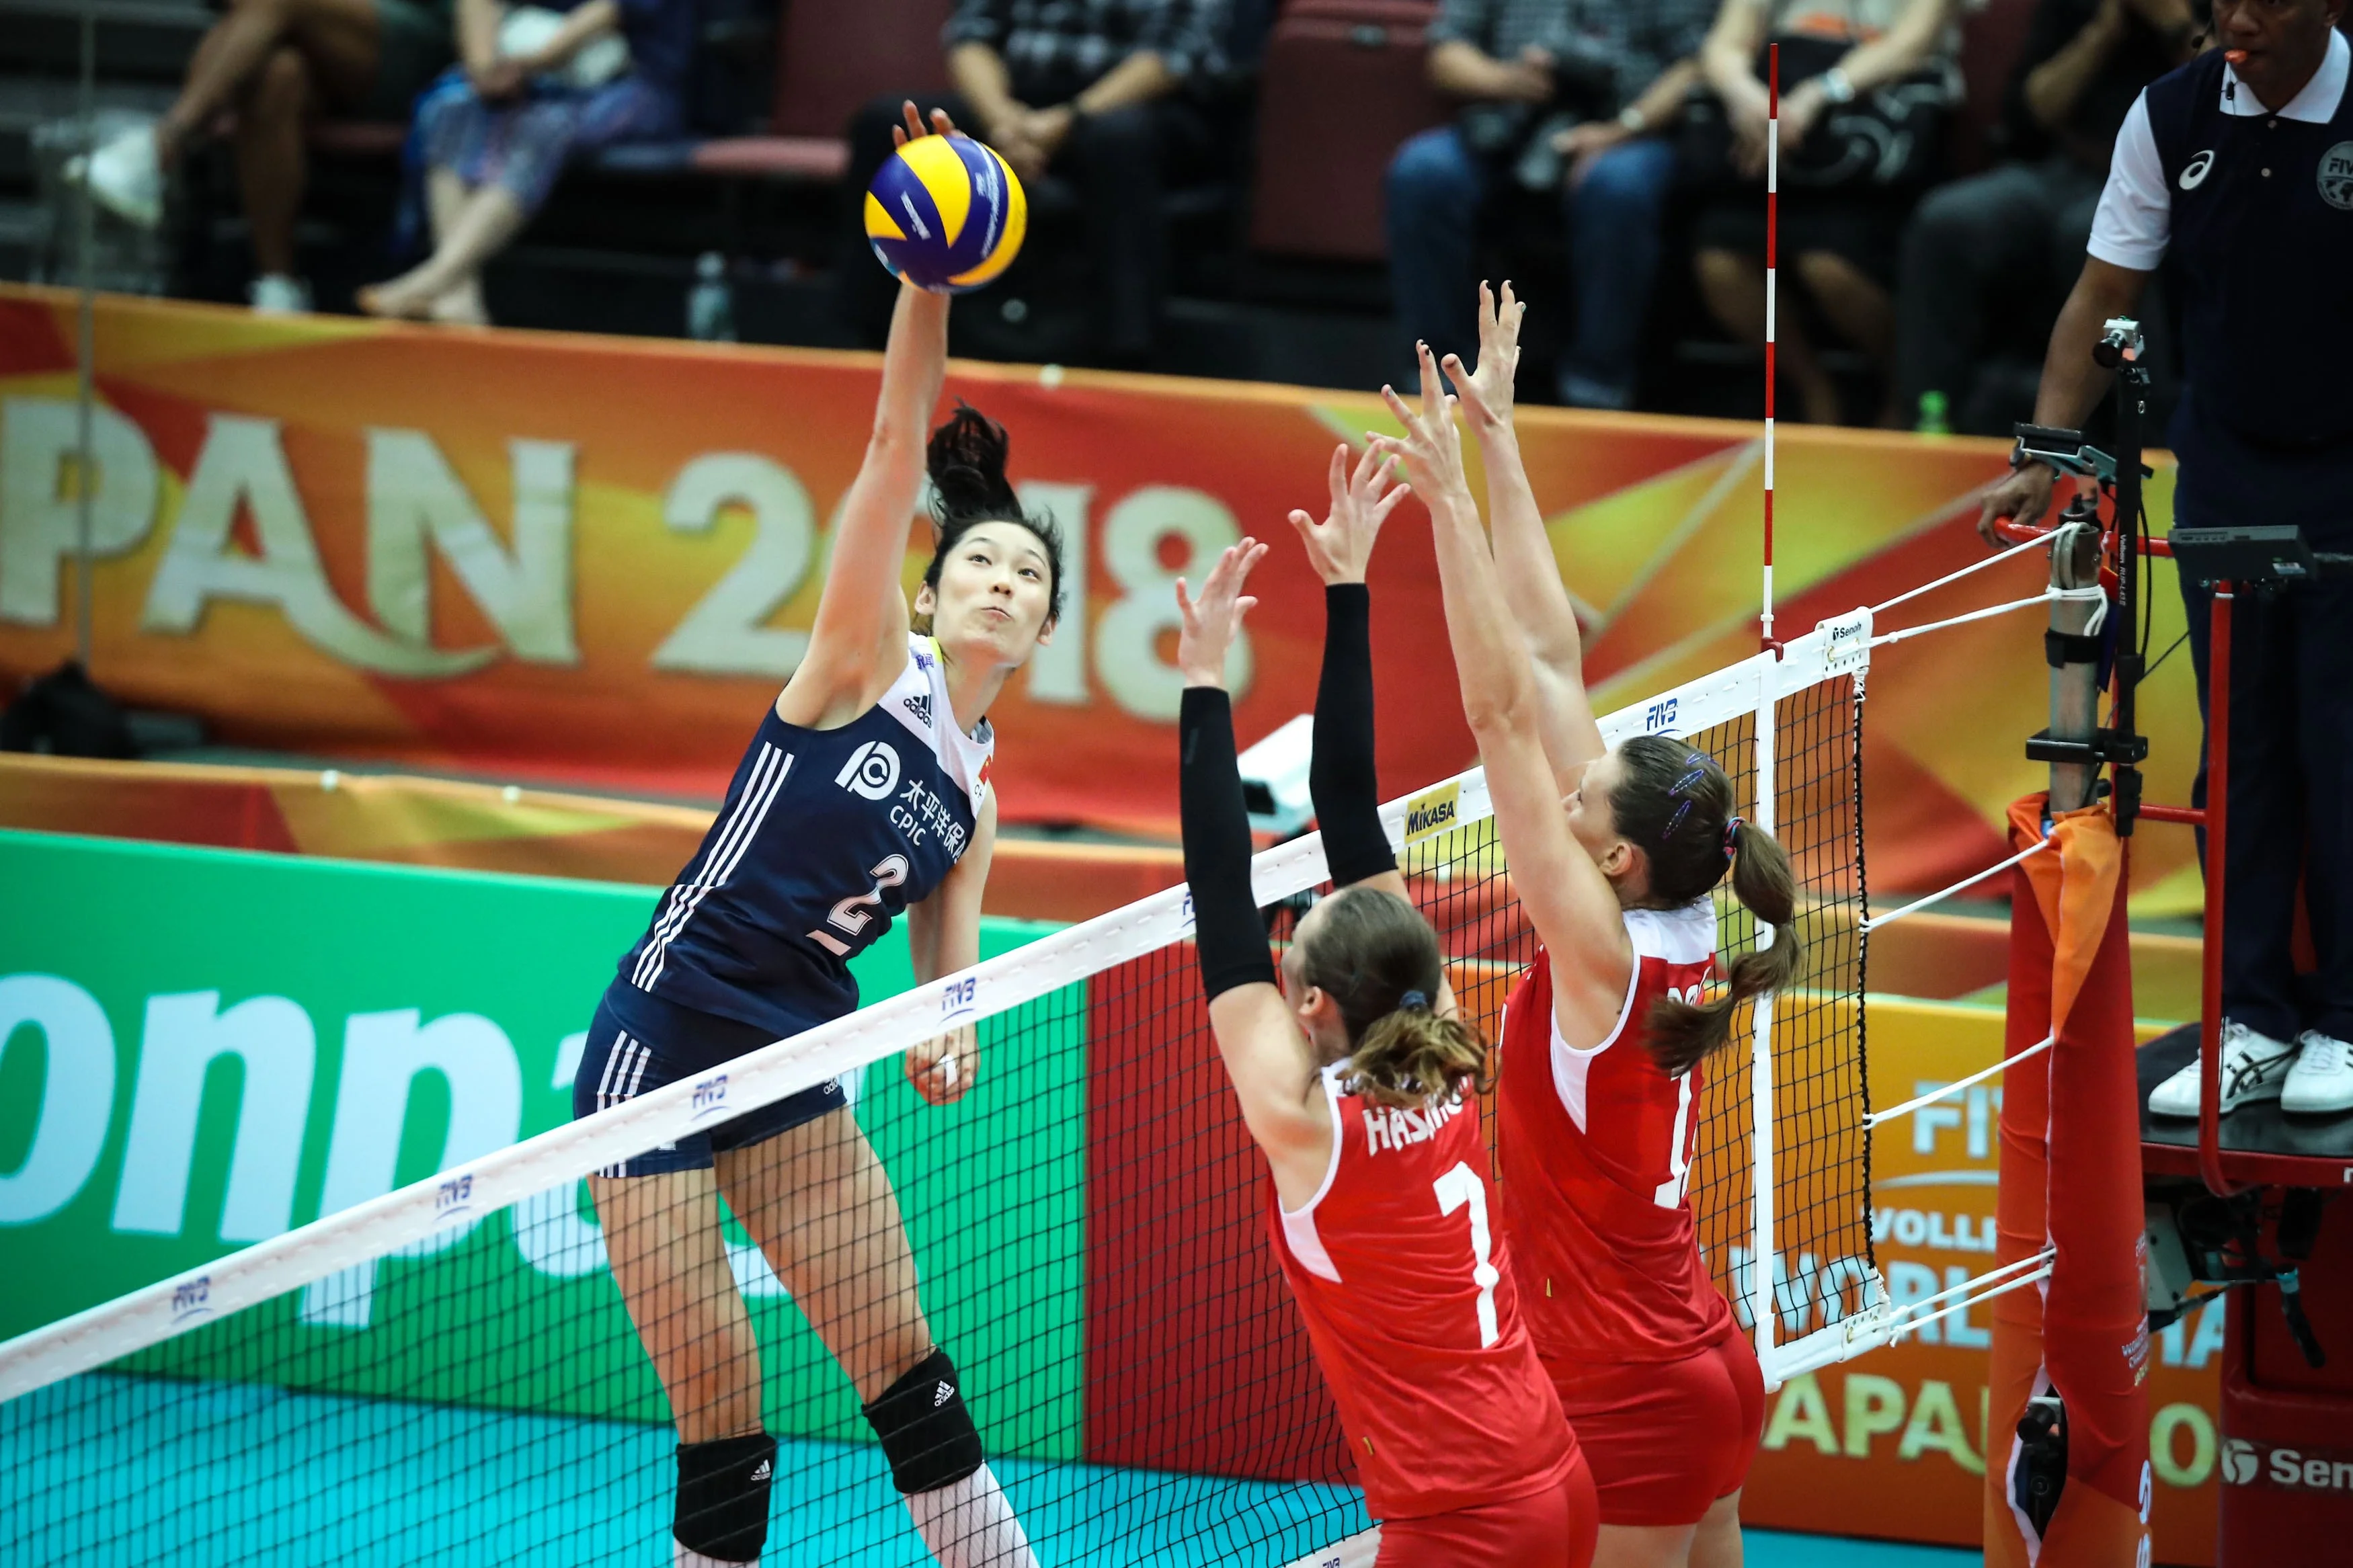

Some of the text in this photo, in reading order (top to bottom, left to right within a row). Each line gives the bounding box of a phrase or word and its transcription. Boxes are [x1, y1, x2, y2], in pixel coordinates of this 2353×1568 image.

[652, 450, 1254, 724] 218
[1840, 622, 1862, 638] Senoh
[903, 698, 932, 729] adidas
[1646, 698, 1678, 732] FIVB
[889, 805, 926, 847] CPIC
[828, 854, 909, 936] 2
[1761, 1372, 1989, 1476] APA
